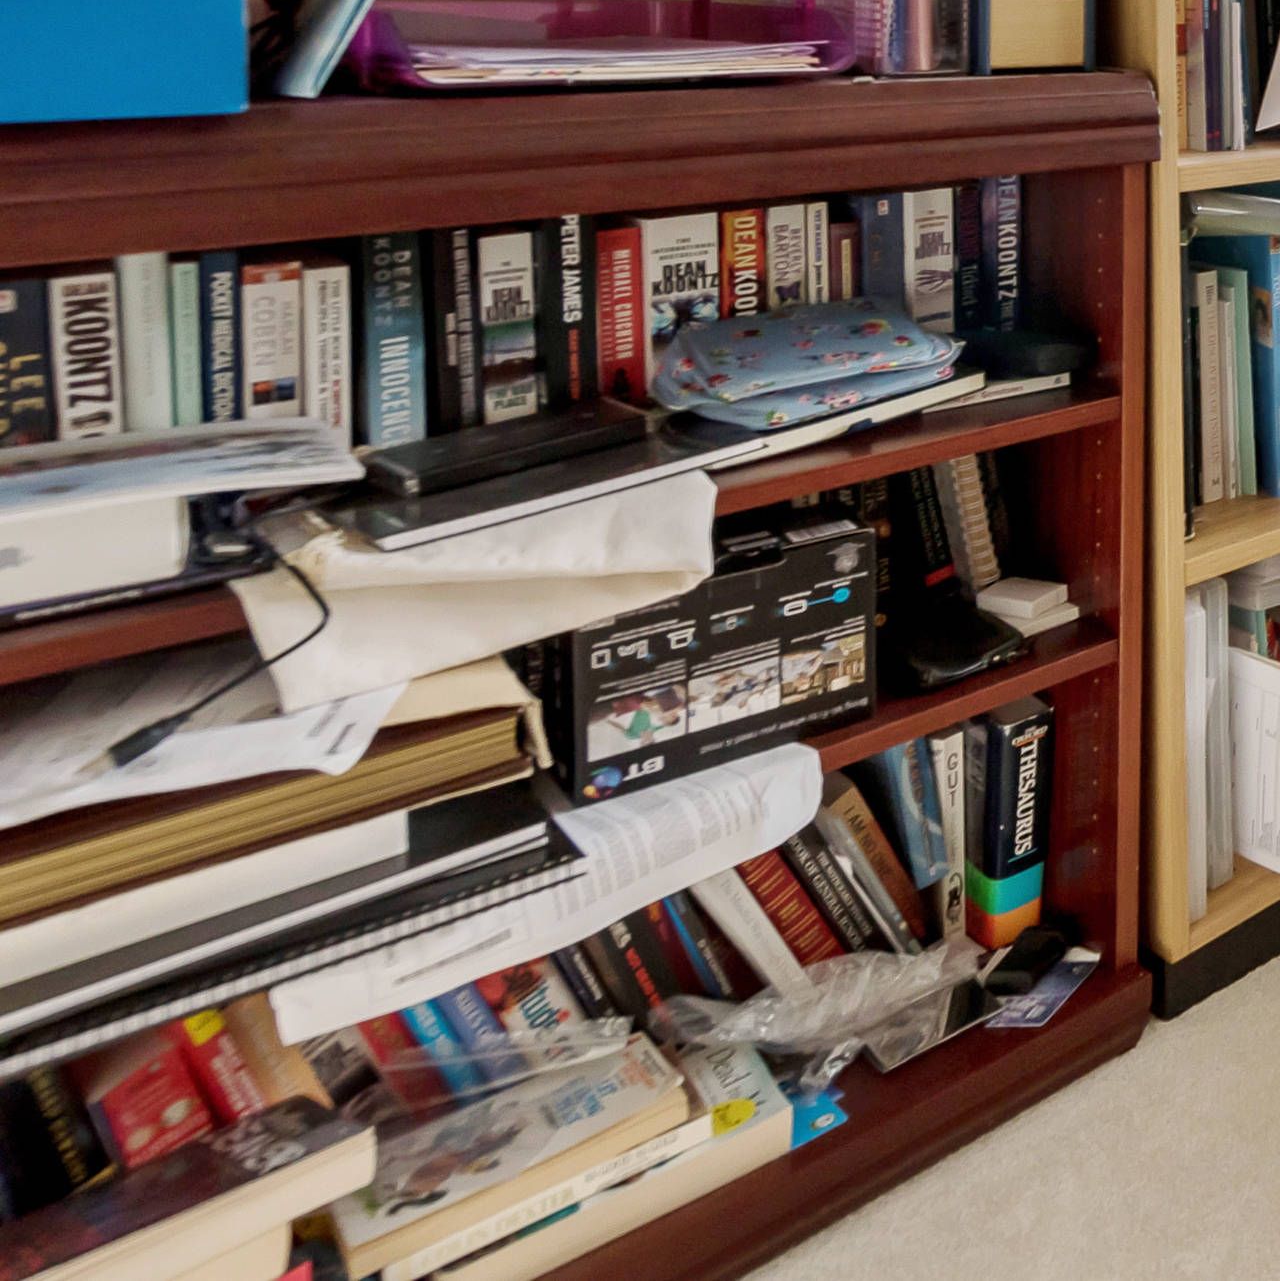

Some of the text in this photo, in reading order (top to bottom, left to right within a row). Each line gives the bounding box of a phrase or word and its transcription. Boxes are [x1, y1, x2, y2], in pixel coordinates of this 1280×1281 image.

[373, 236, 392, 326] KOONTZ
[392, 250, 412, 308] DEAN
[561, 214, 582, 323] PETER JAMES
[612, 249, 633, 300] MICHAEL
[662, 260, 708, 280] DEAN
[734, 216, 758, 317] DEAN KOO
[773, 223, 790, 284] BARTON
[790, 227, 802, 278] BEVERLY
[997, 223, 1019, 301] KOONTZ
[652, 273, 720, 296] KOONTZ
[63, 296, 114, 409] KOONTZ
[253, 296, 278, 368] COBEN
[614, 302, 635, 361] CRICHTON
[9, 353, 46, 415] LEE
[212, 371, 236, 423] DICTION
[380, 335, 412, 447] INNOCENC
[627, 755, 665, 781] BT
[947, 752, 959, 808] GUT
[1013, 737, 1040, 857] THESAURUS
[847, 813, 867, 834] AM
[809, 872, 846, 918] GENERAL
